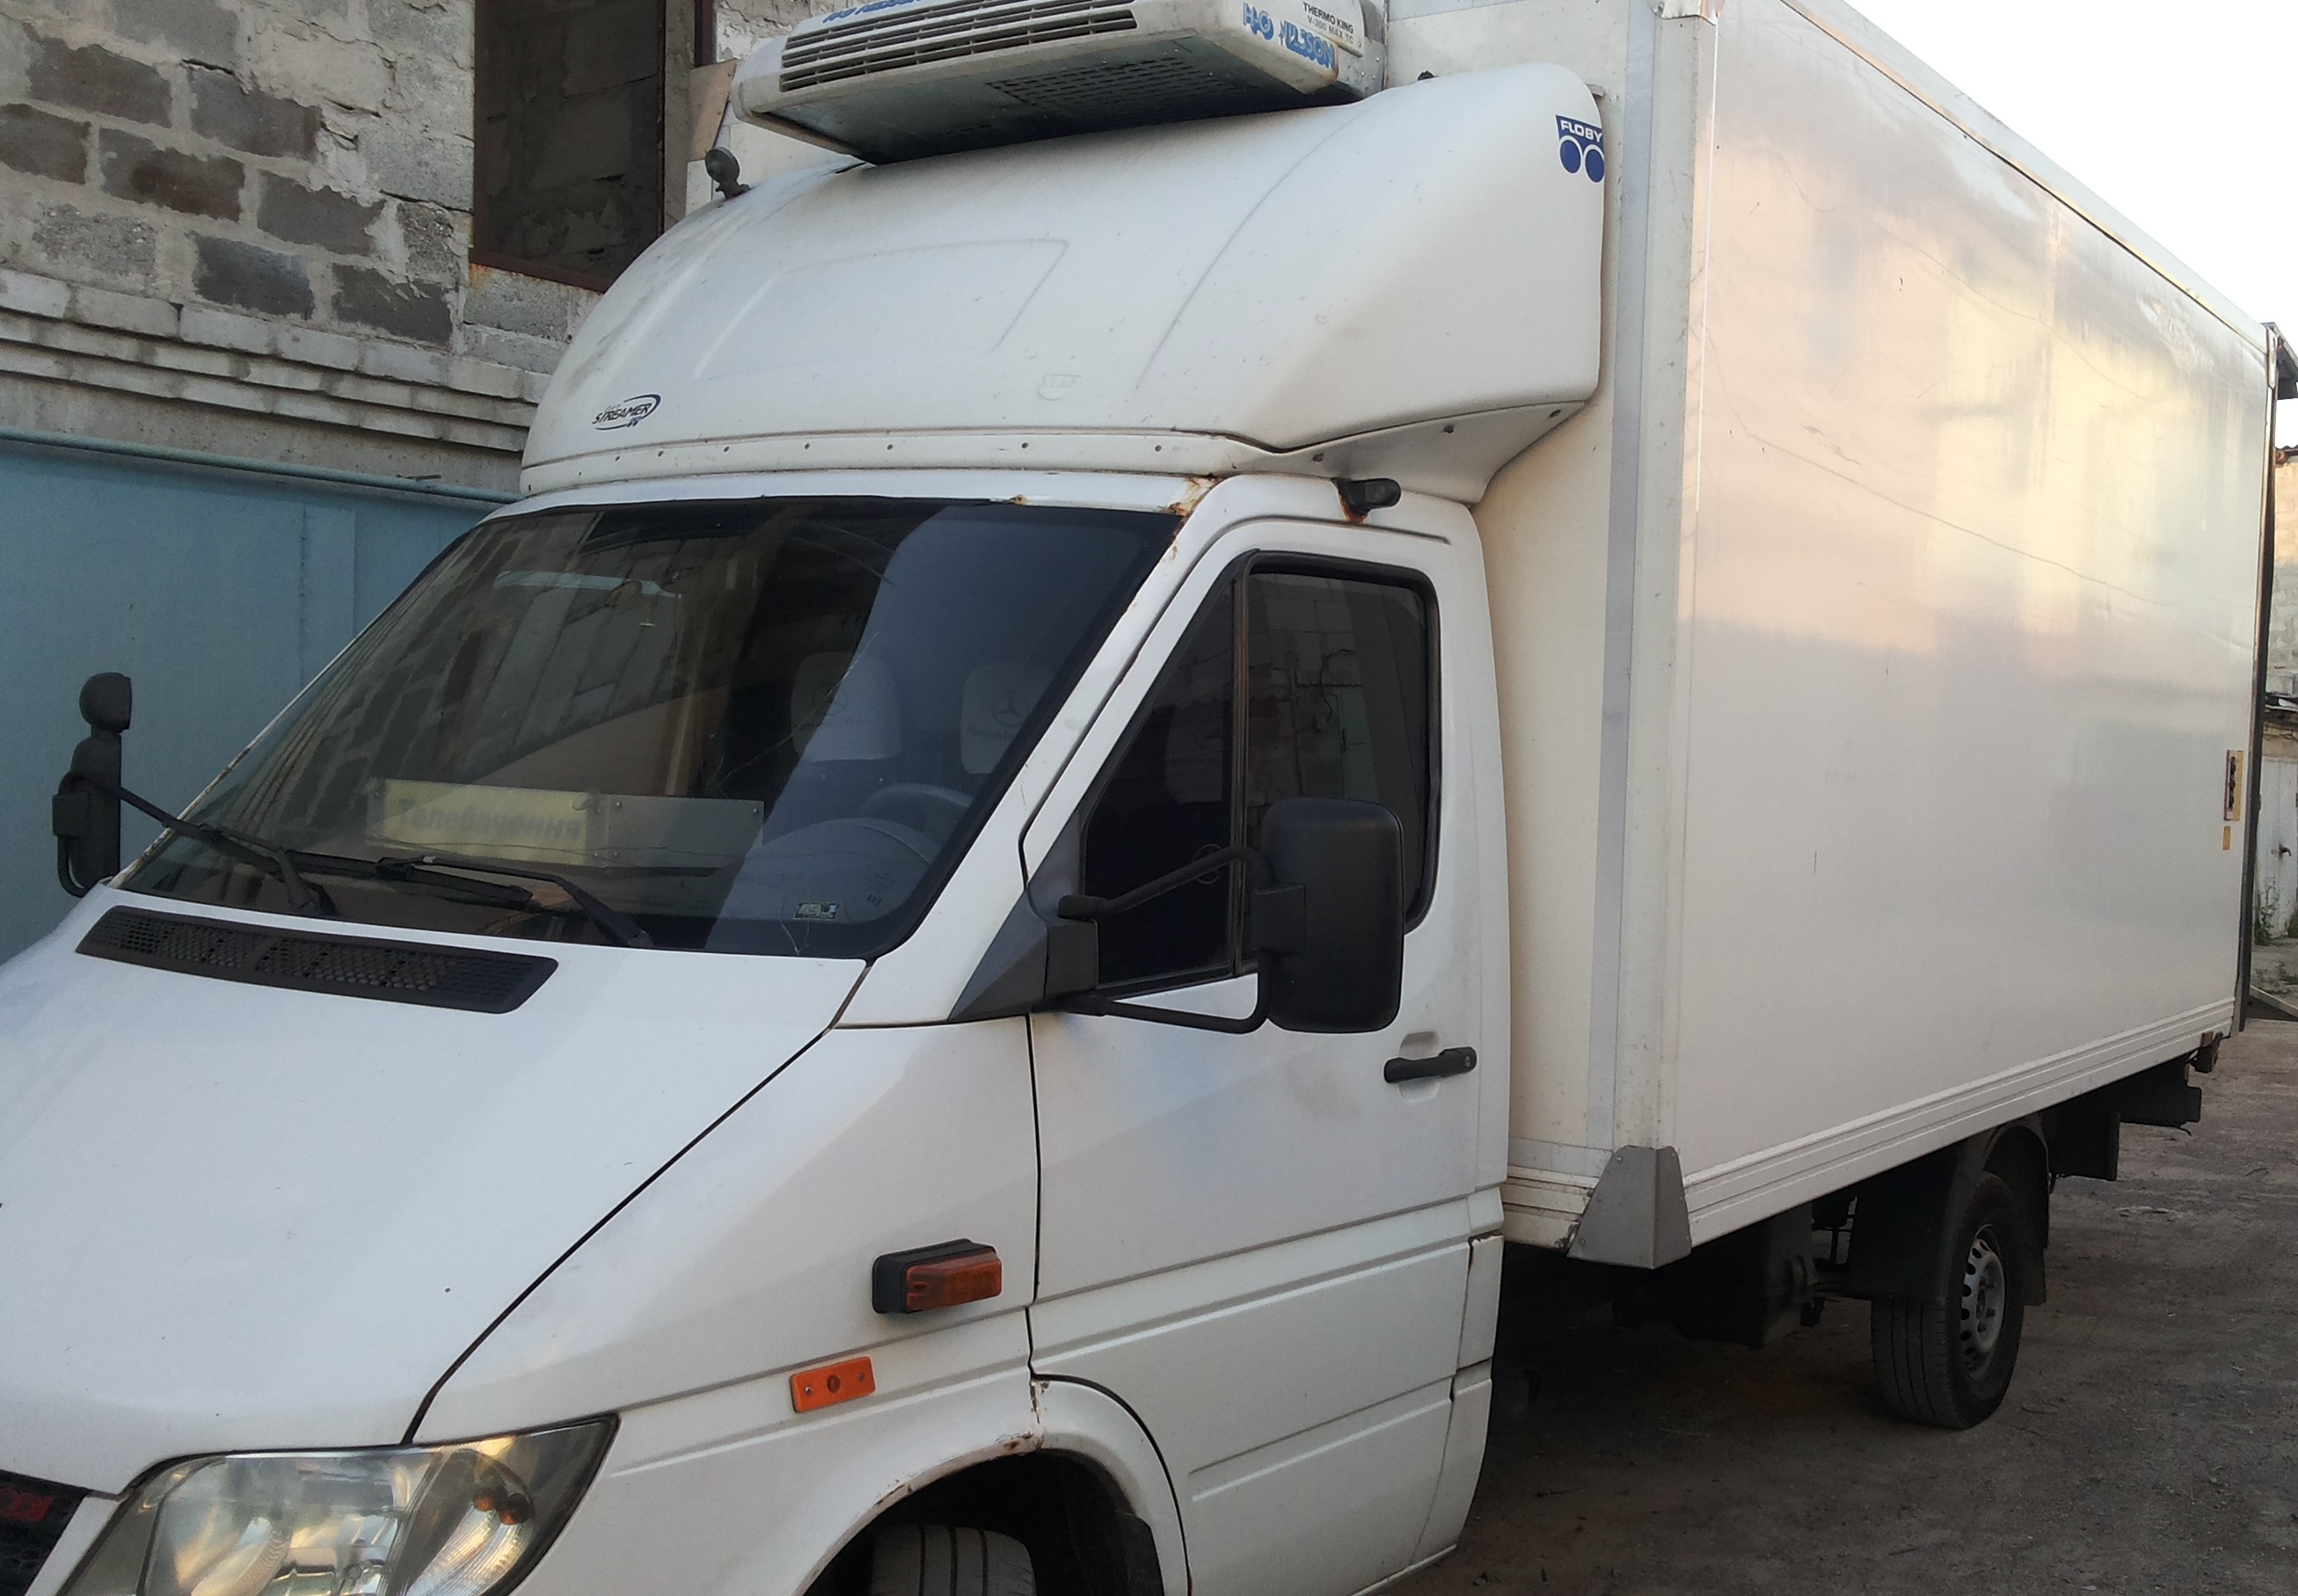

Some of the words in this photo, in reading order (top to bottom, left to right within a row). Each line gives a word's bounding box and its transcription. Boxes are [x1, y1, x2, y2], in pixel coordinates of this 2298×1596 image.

[1302, 2, 1336, 25] THERMO
[1336, 18, 1354, 34] KING
[1344, 33, 1354, 44] TC
[1560, 120, 1602, 142] FLOBY
[592, 403, 653, 425] STREAMER
